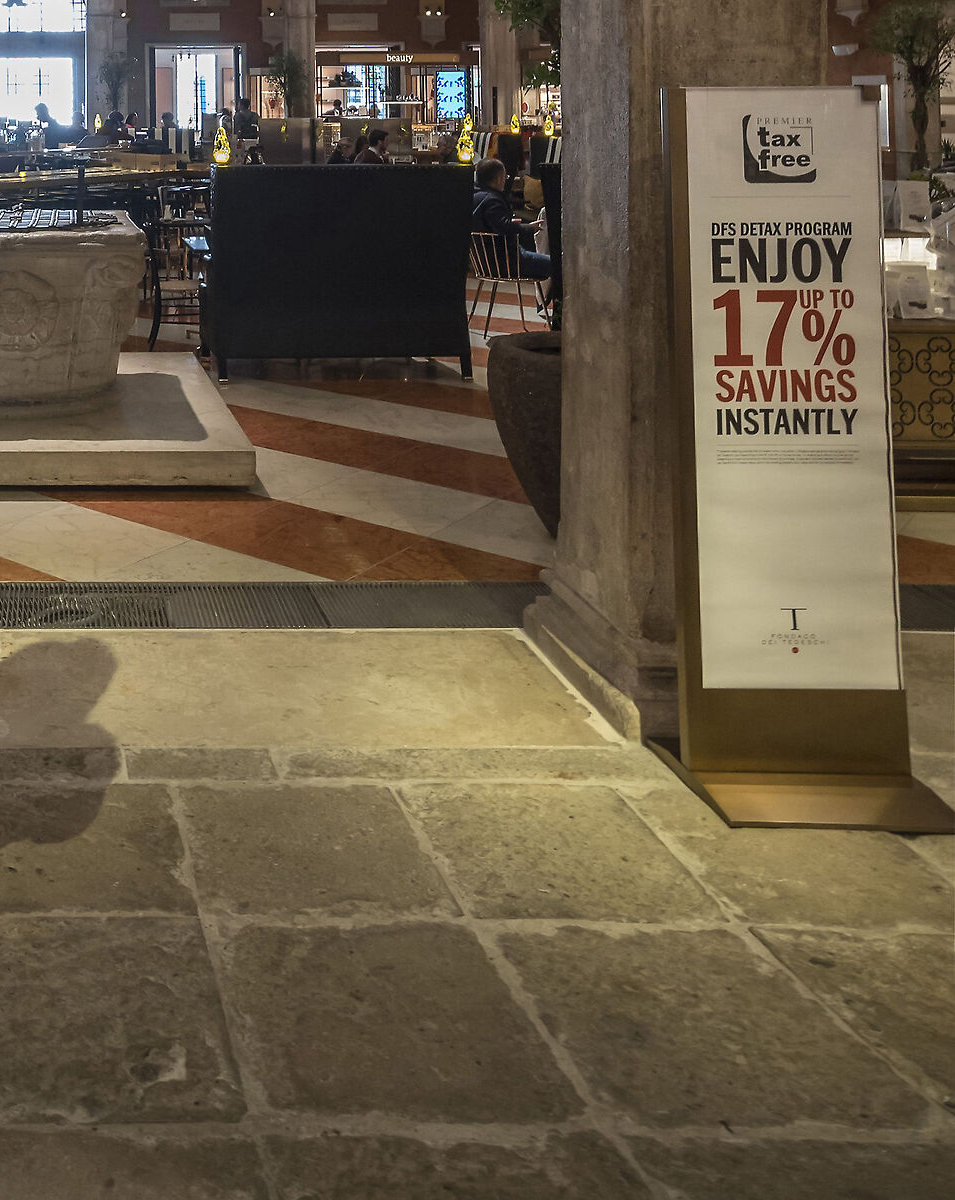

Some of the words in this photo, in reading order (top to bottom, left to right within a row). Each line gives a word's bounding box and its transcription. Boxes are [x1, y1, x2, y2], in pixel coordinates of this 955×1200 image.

[386, 53, 414, 63] beauty
[756, 117, 812, 125] PREMIER
[757, 126, 802, 147] tax
[757, 148, 811, 170] free
[711, 222, 737, 236] DFS
[740, 222, 782, 236] DETAX
[785, 221, 852, 236] PROGRAM
[711, 237, 852, 284] ENJOY
[799, 289, 825, 309] UP
[829, 289, 855, 309] TO
[715, 369, 858, 403] SAVINGS
[716, 408, 859, 436] INSTANTLY
[780, 608, 807, 631] T
